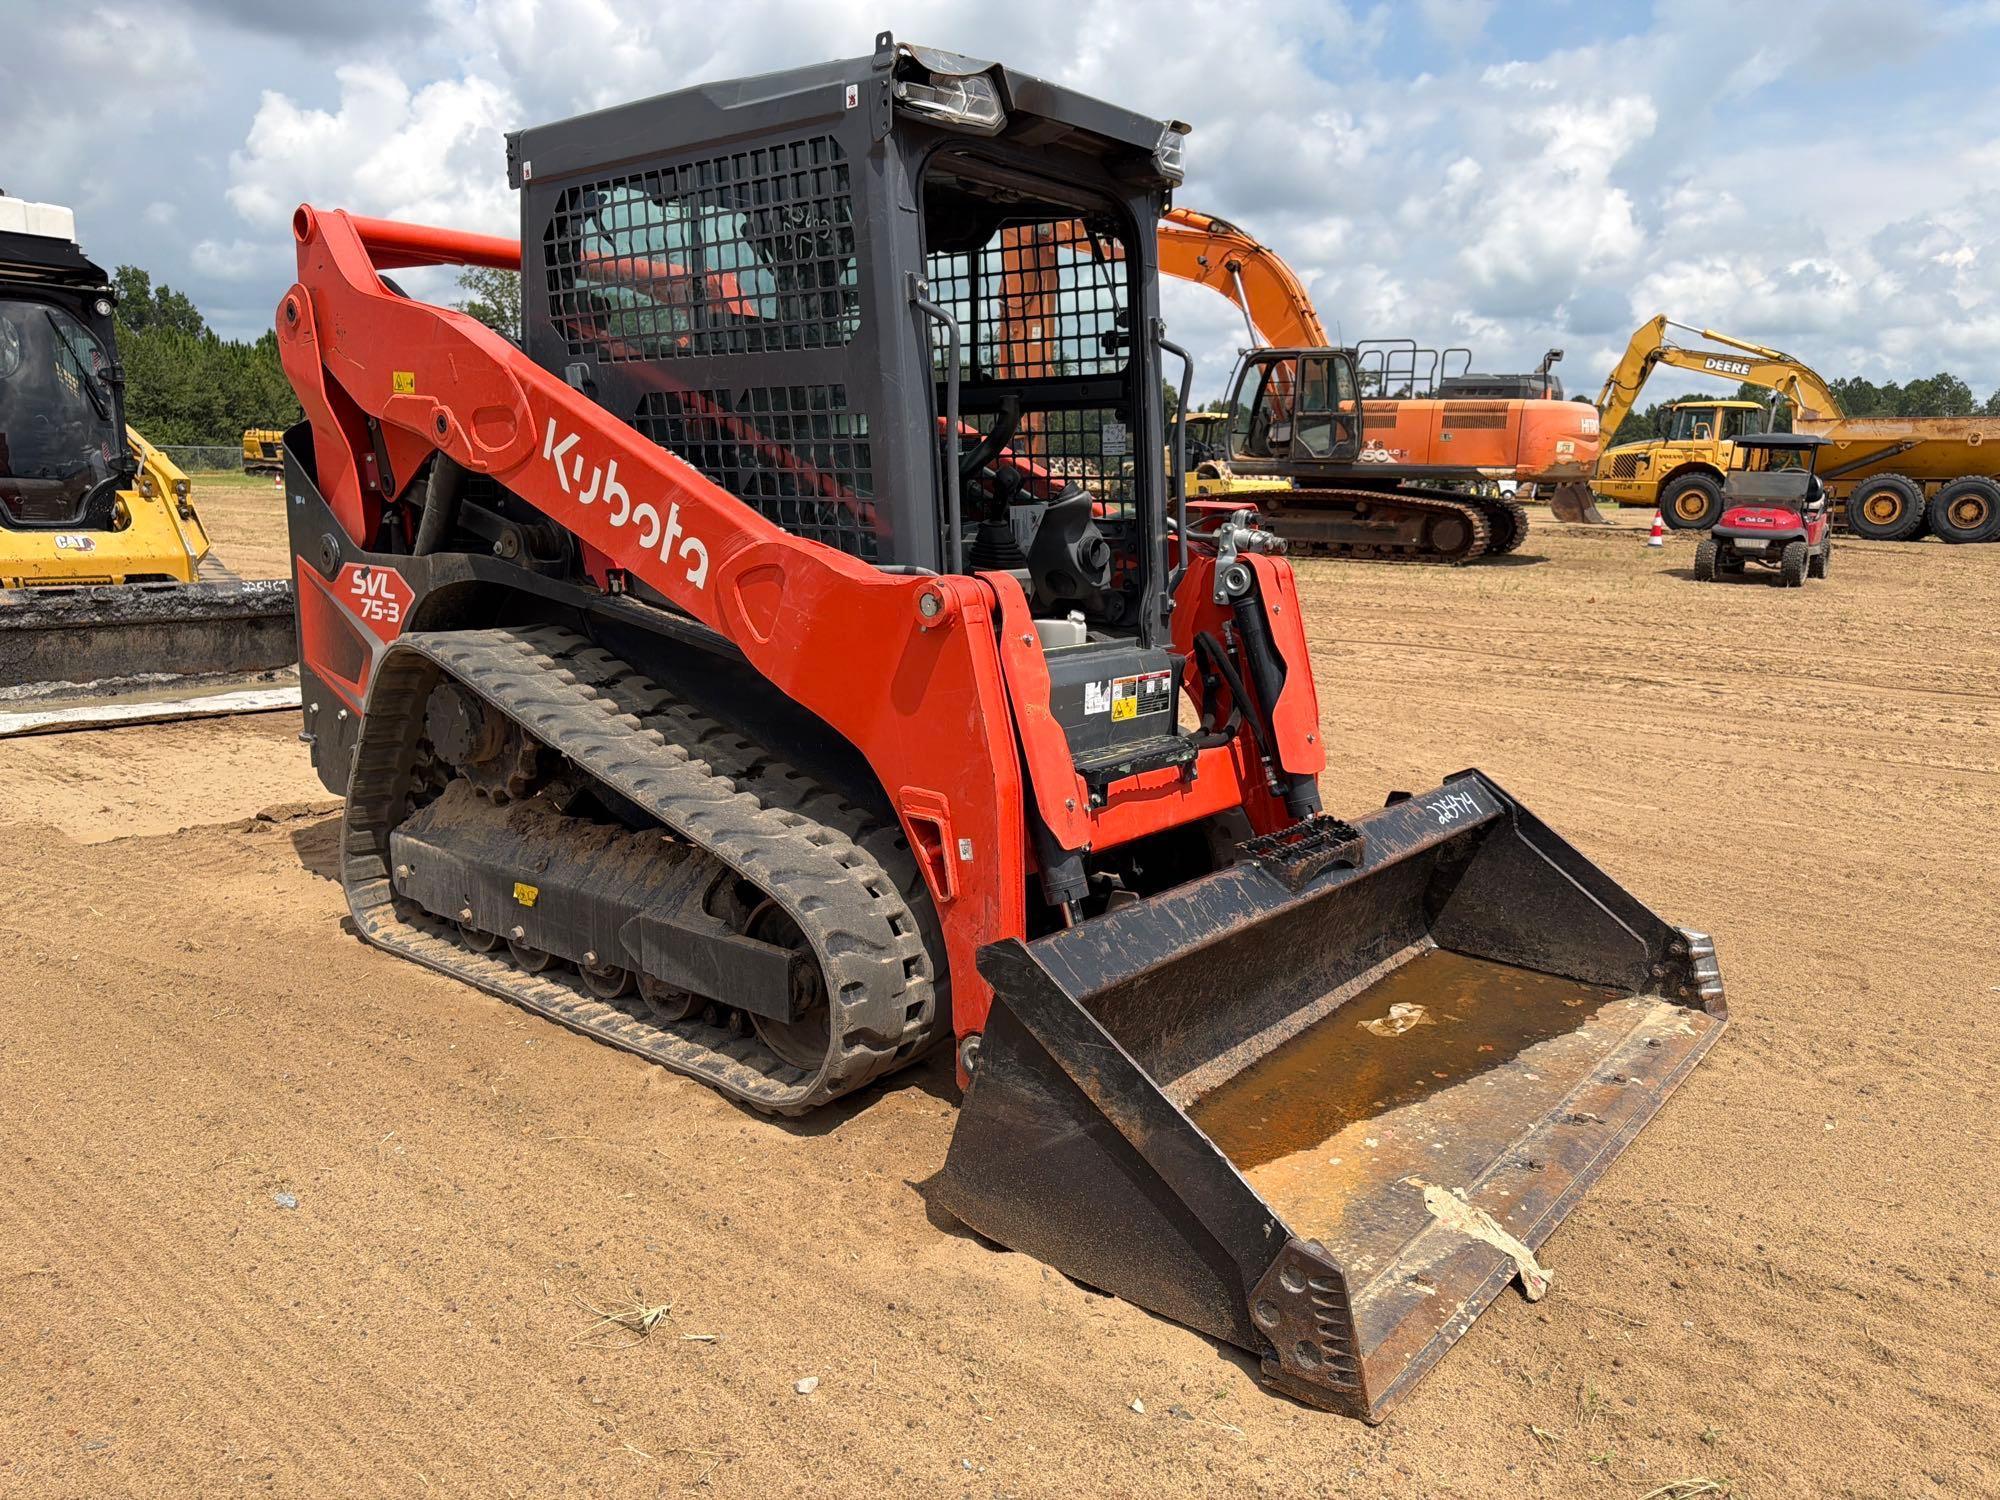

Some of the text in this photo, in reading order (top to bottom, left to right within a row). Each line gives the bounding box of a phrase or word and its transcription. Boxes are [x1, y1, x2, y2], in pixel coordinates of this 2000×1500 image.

[1704, 358, 1751, 375] DEERE
[1359, 448, 1389, 463] 50
[542, 416, 710, 591] Kubota
[54, 535, 88, 550] CAT
[350, 569, 396, 600] SVL
[360, 597, 400, 624] 75-3
